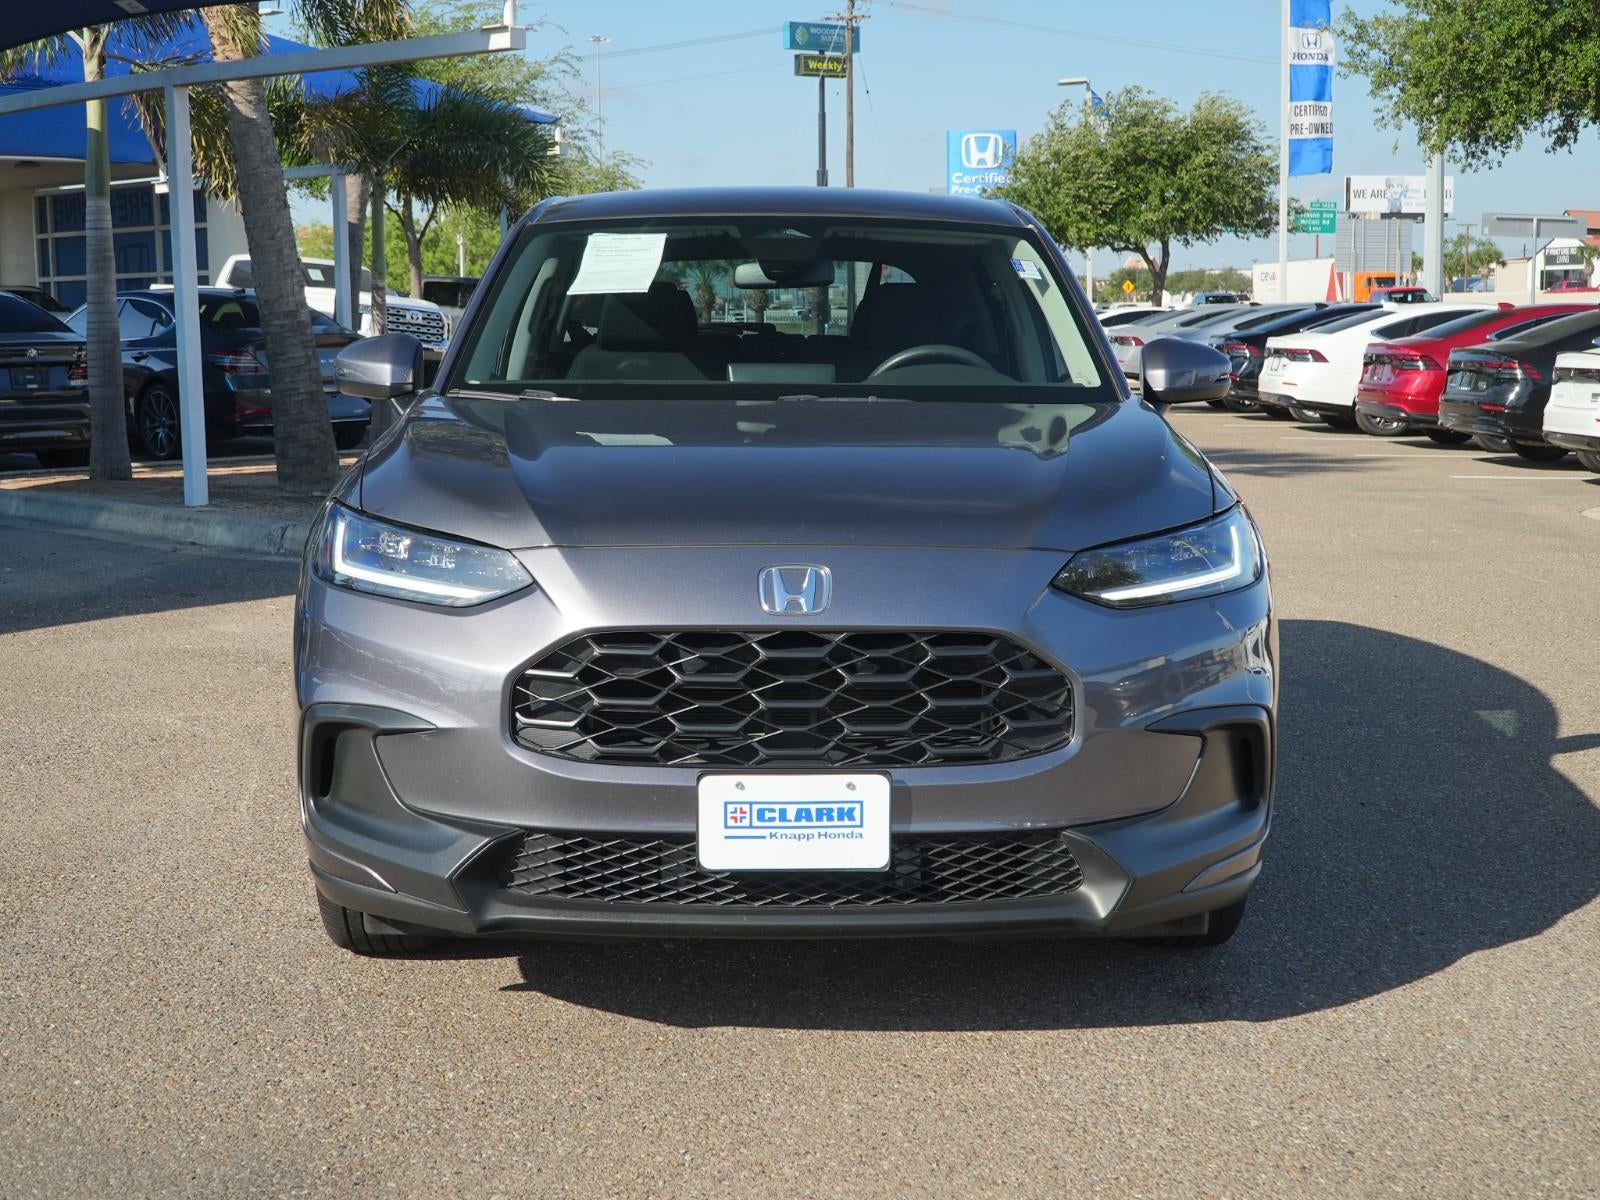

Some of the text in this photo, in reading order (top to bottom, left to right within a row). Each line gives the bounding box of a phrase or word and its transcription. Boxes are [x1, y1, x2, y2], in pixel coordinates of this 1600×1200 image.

[1292, 52, 1329, 61] HONDA
[808, 60, 843, 73] Weekly
[1290, 122, 1333, 135] PRE-OWNED
[951, 185, 983, 194] Pre-O
[1353, 189, 1388, 199] WE ARE
[756, 807, 857, 823] CLARK
[769, 831, 863, 842] Knapp Honda
